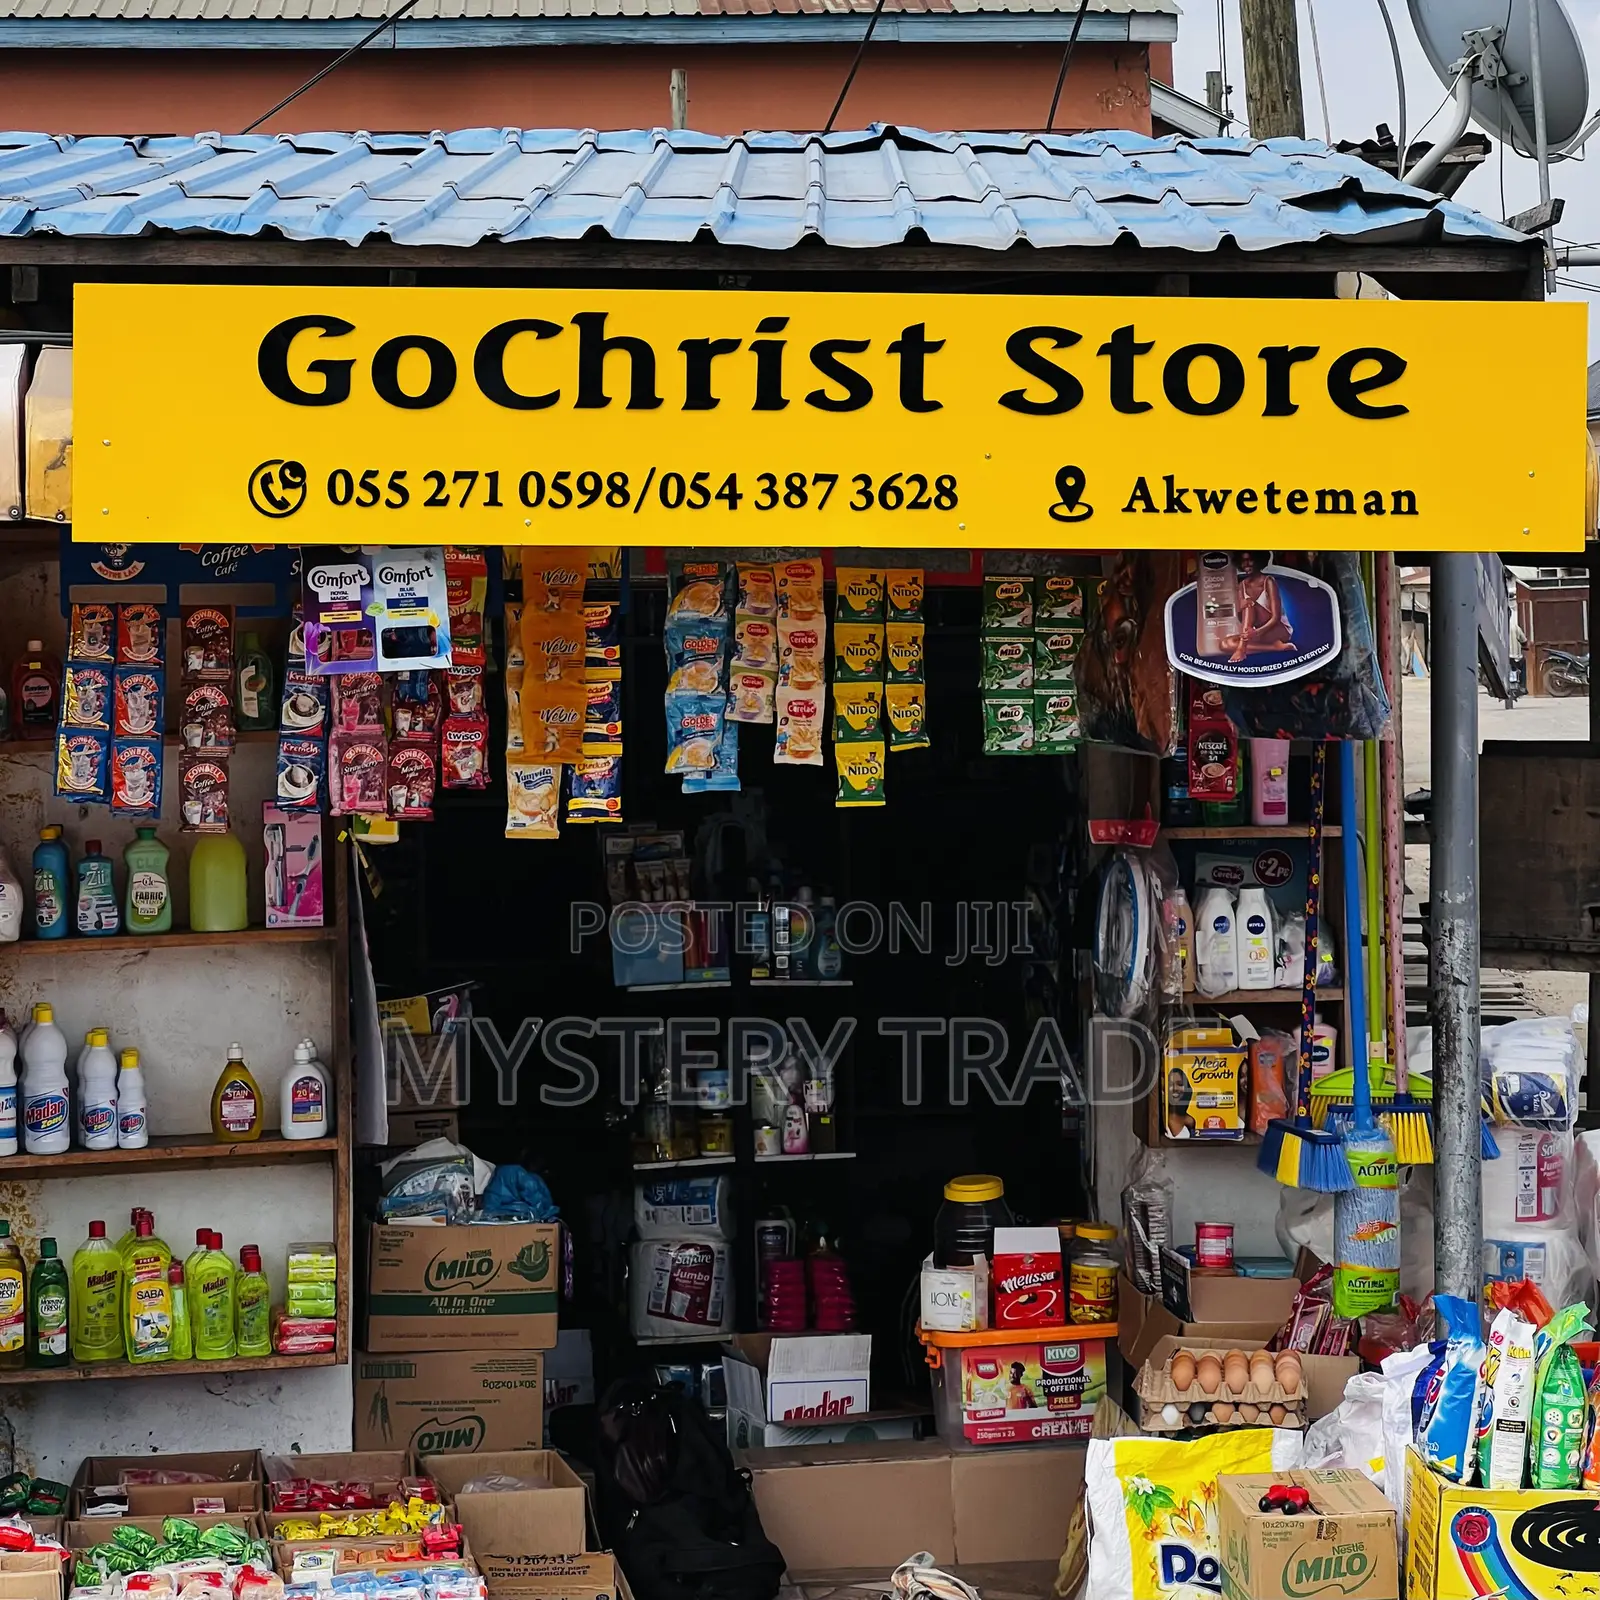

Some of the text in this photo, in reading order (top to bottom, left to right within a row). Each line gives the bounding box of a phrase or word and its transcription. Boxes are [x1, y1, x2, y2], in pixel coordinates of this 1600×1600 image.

[257, 311, 1410, 420] GoChrist Store
[326, 466, 959, 514] 055 271 0598/054 387 3628
[1121, 475, 1420, 516] Akweteman
[201, 545, 249, 567] Coffee
[312, 569, 366, 589] Comfort
[379, 566, 433, 585] Comfort
[848, 587, 878, 596] NIDO
[892, 588, 920, 597] NIDO
[999, 586, 1021, 594] MILO
[189, 609, 225, 625] COWBELL
[683, 639, 719, 650] GOLDEN
[790, 635, 816, 645] Cerelac
[1049, 639, 1071, 647] MILO
[846, 647, 876, 657] NIDO
[892, 649, 919, 658] NIDO
[999, 648, 1021, 656] MILO
[1179, 643, 1330, 673] FOR BEAUTIFULLY MOISTURIZED SKIN EVERYDAY
[788, 704, 815, 715] Cerelac
[847, 705, 877, 715] NIDO
[1047, 700, 1071, 709] MILO
[892, 709, 920, 719] NIDO
[999, 709, 1021, 718] MILO
[681, 716, 717, 728] GOLDEN
[119, 747, 153, 762] COWBELL
[395, 749, 430, 764] COWBELL
[186, 764, 223, 780] COWBELL
[848, 764, 878, 776] NIDO
[87, 870, 105, 886] Zii
[1212, 869, 1242, 880] Cerelac
[135, 891, 164, 901] FABRIC
[1192, 1056, 1227, 1071] Mega
[1191, 1068, 1234, 1083] Growth
[227, 1090, 248, 1098] STAIN
[296, 1090, 308, 1098] 20
[26, 1098, 65, 1123] Madar
[435, 1258, 493, 1281] MILO
[673, 1268, 710, 1282] Jumbo
[87, 1269, 117, 1288] Madar
[1001, 1271, 1055, 1294] Melissa
[203, 1277, 229, 1293] Madar
[136, 1288, 164, 1300] SABA
[429, 1296, 496, 1307] All In One
[1046, 1347, 1077, 1360] KIVO
[482, 1379, 537, 1389] 30x10x20g
[1035, 1375, 1091, 1388] PROMOTIONAL
[1050, 1384, 1078, 1393] OFFER!
[1053, 1395, 1075, 1404] FREE
[1031, 1421, 1093, 1437] CREAME
[417, 1427, 475, 1449] MILO
[1261, 1520, 1305, 1530] 10x20x37g
[1331, 1541, 1365, 1556] Nestlé
[528, 1569, 588, 1577] REFRIGERATE
[1295, 1552, 1368, 1585] MILO
